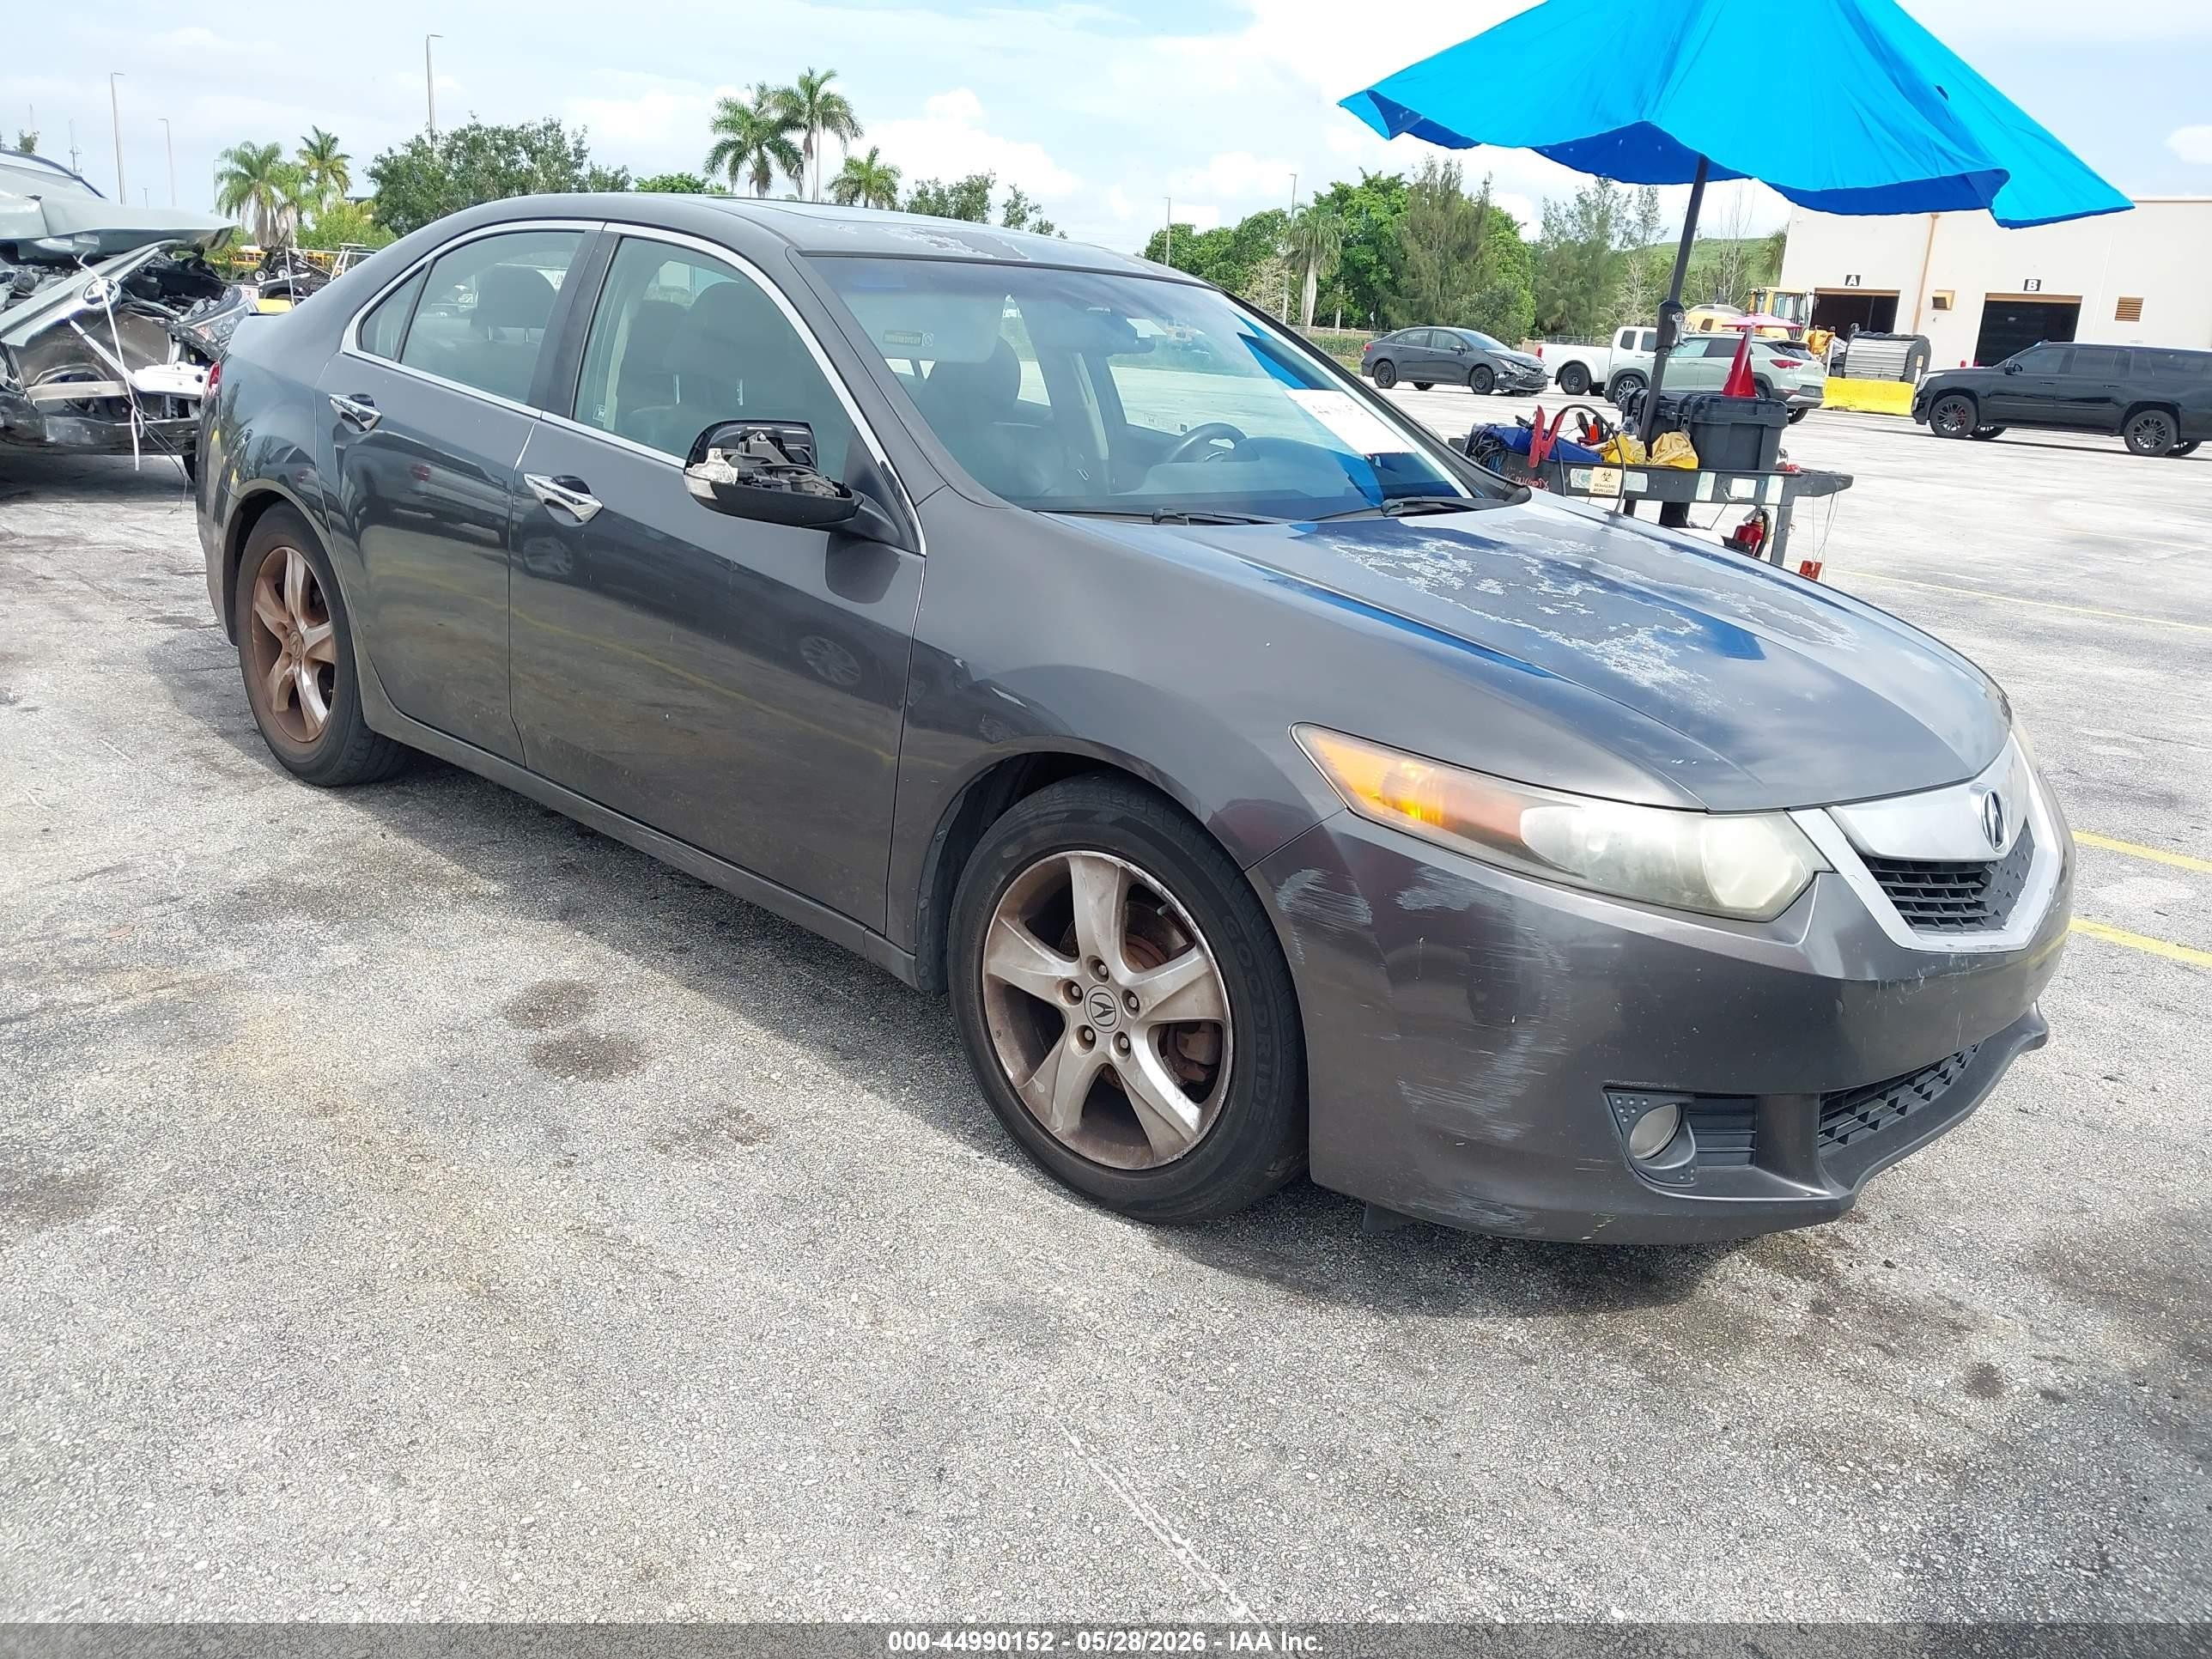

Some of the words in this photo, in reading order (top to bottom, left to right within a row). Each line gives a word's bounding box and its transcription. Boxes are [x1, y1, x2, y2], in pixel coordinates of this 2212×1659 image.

[1846, 275, 1858, 286] A
[2027, 279, 2039, 291] B
[1222, 915, 1273, 1121] GOODRIDE
